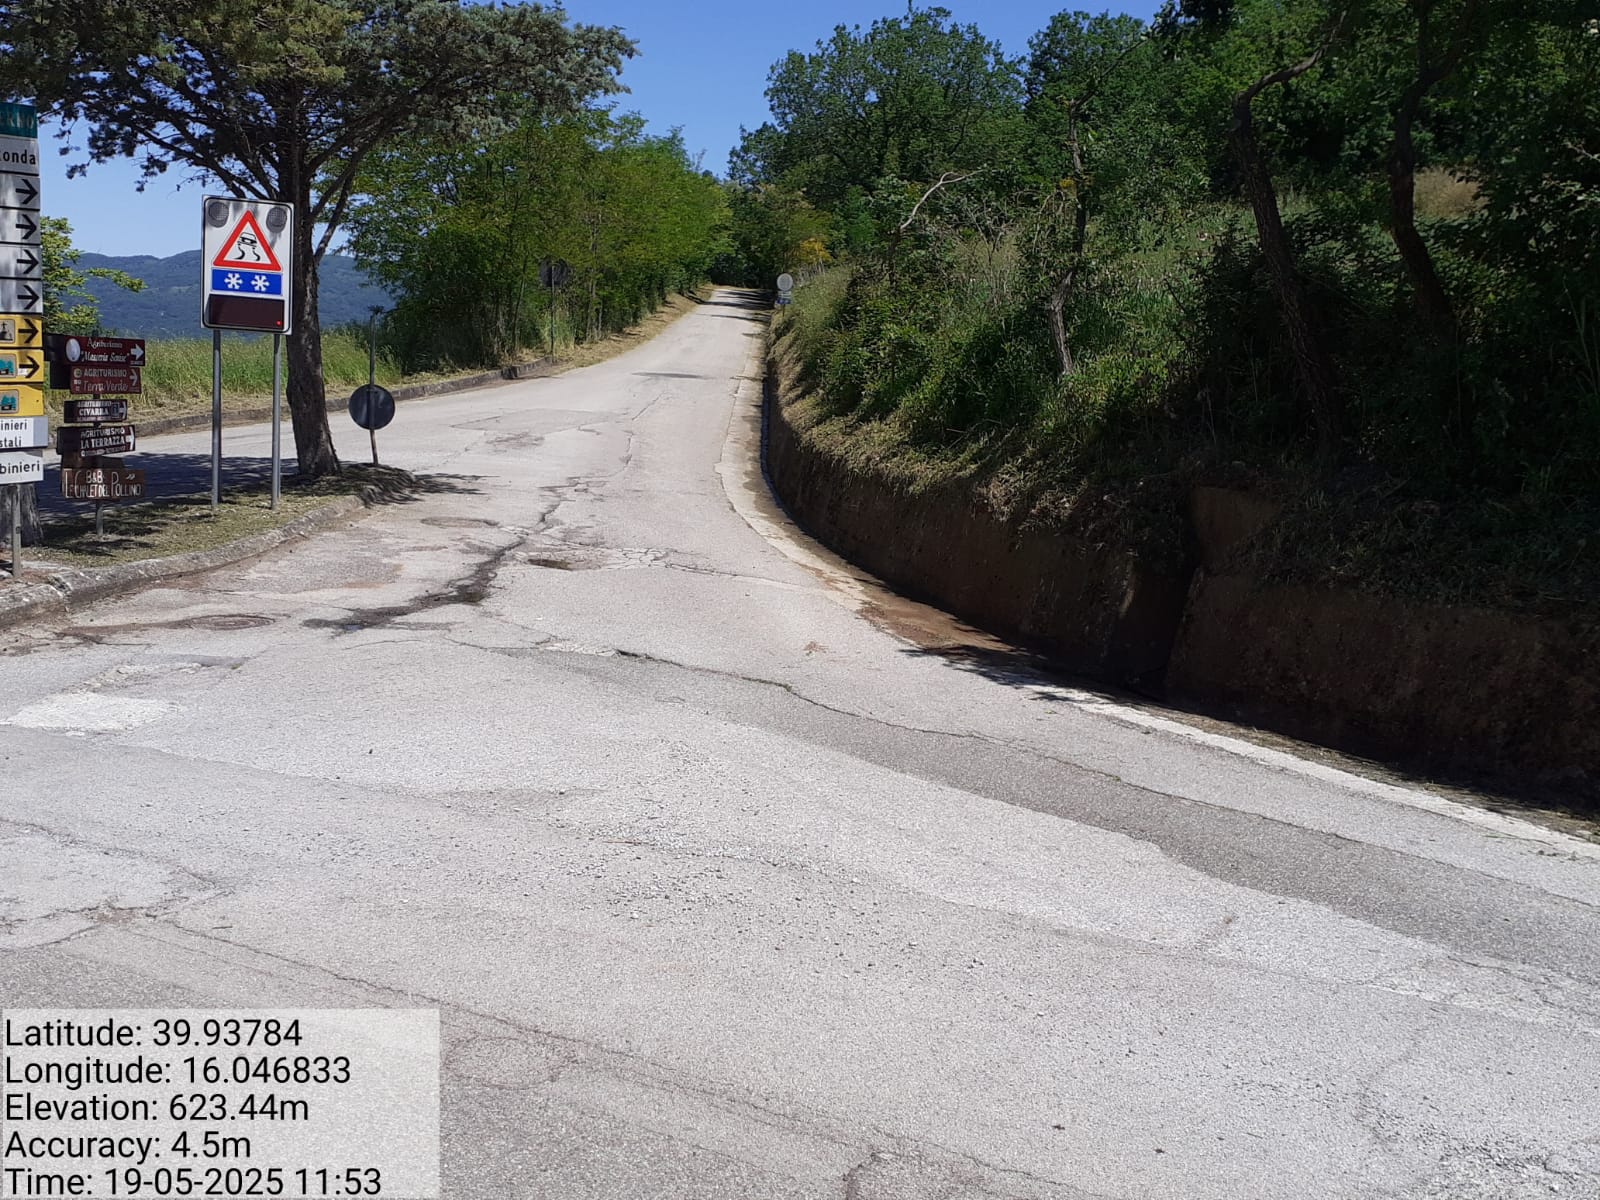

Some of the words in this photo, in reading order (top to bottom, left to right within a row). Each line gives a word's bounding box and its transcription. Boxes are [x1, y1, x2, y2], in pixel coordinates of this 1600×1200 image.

[0, 149, 36, 165] onda
[84, 368, 127, 378] AGRITURISMO
[81, 439, 90, 450] LA
[91, 435, 125, 448] TERRAZZA
